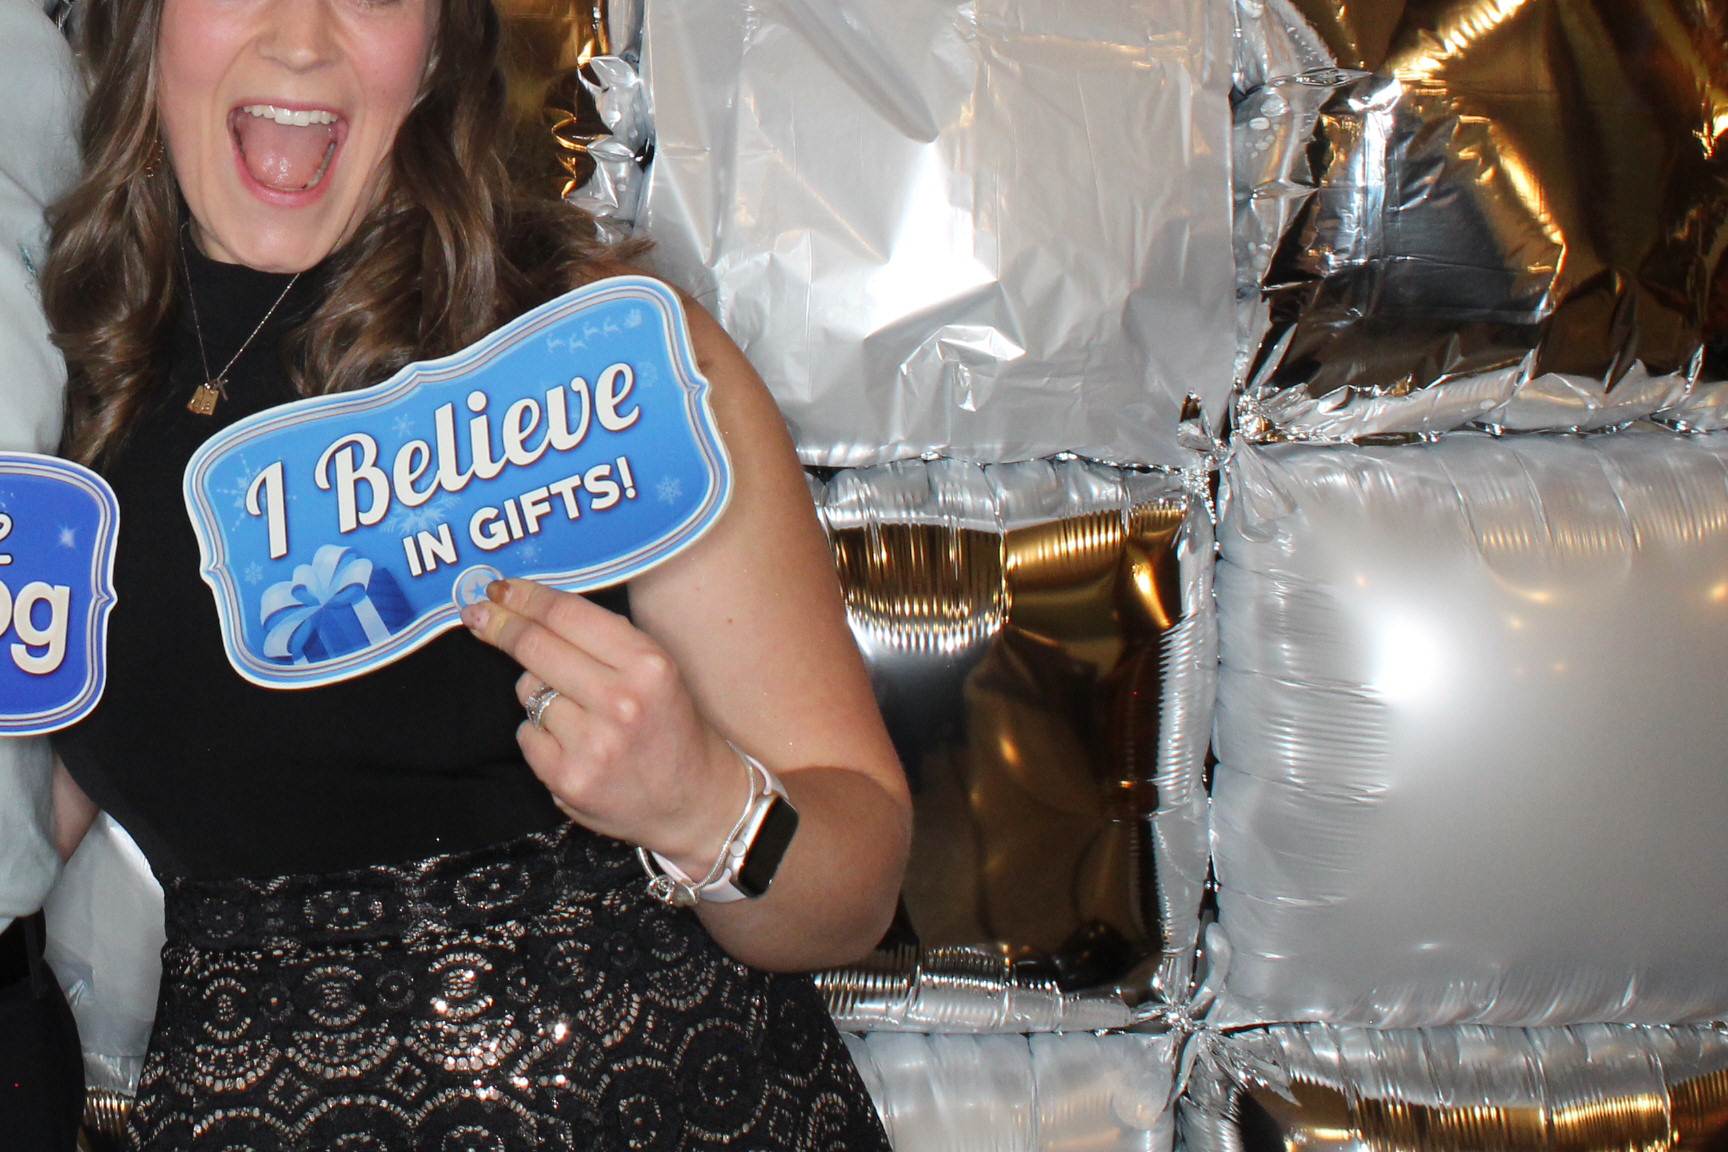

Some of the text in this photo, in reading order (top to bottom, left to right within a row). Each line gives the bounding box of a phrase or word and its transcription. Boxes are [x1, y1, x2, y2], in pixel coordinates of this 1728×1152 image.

[245, 362, 641, 559] I Believe
[402, 455, 638, 577] IN GIFTS!
